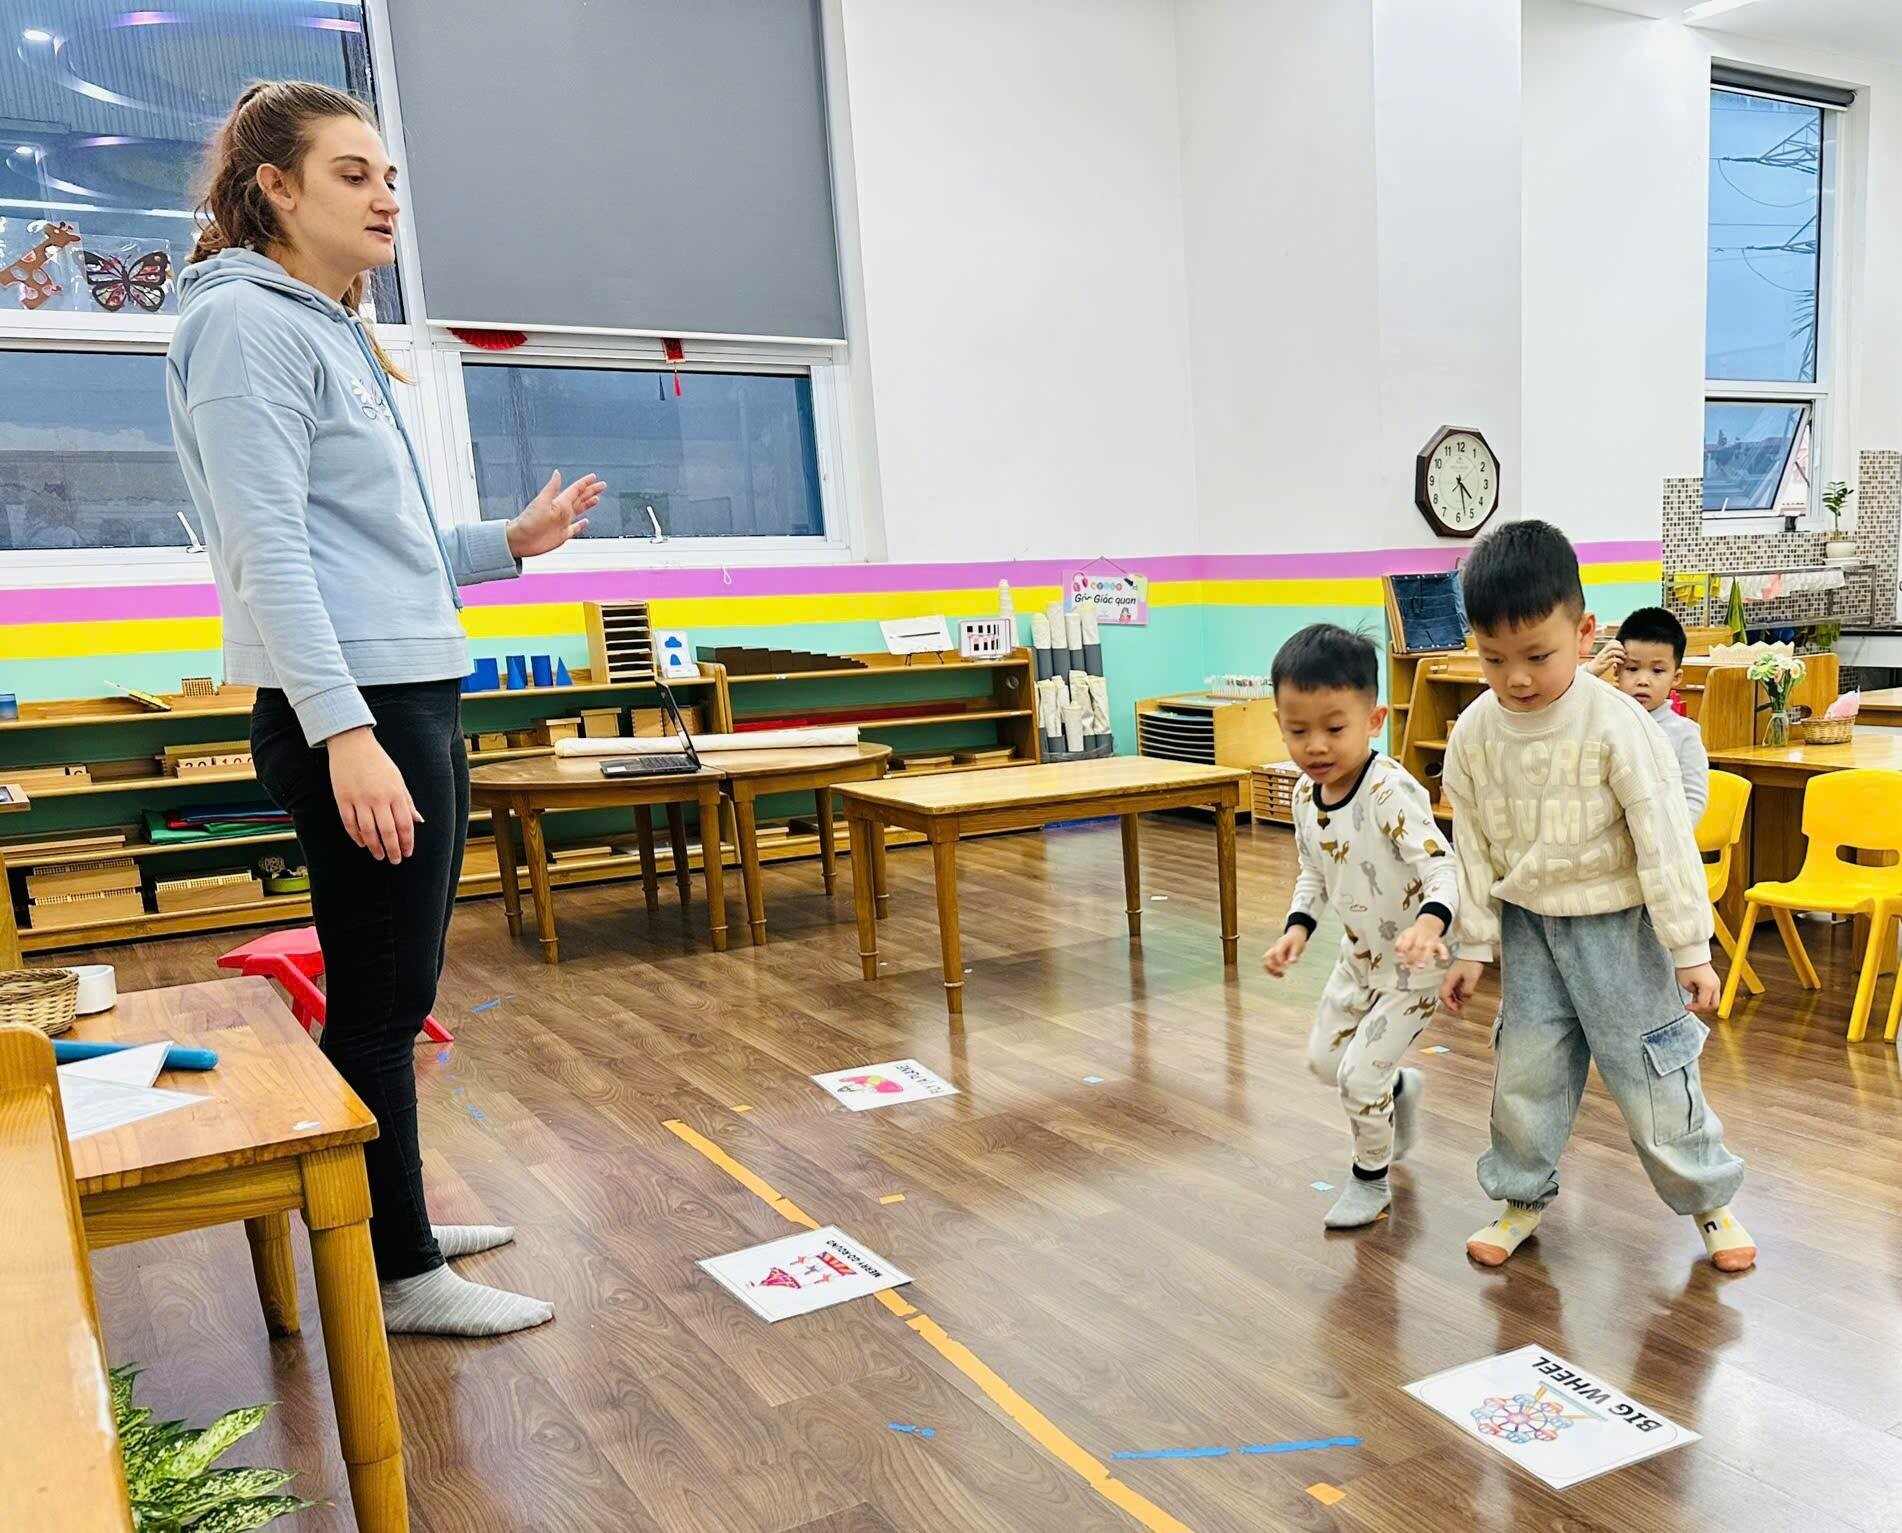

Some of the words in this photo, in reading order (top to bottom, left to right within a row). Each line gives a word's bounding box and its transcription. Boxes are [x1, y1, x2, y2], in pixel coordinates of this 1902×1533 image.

[1444, 446, 1452, 457] 11
[1456, 441, 1465, 453] 12
[1434, 458, 1442, 470] 10
[1480, 461, 1486, 472] 2
[1429, 475, 1435, 486] 9
[1483, 479, 1489, 490] 3
[1433, 493, 1439, 504] 8
[1478, 496, 1484, 506] 4
[1442, 506, 1447, 517] 7
[1469, 508, 1475, 519] 5
[1455, 512, 1461, 523] 6
[1094, 593, 1113, 604] Giác
[1115, 596, 1137, 606] quan
[1531, 1356, 1611, 1404] WHEEL
[1608, 1403, 1662, 1433] BIG
